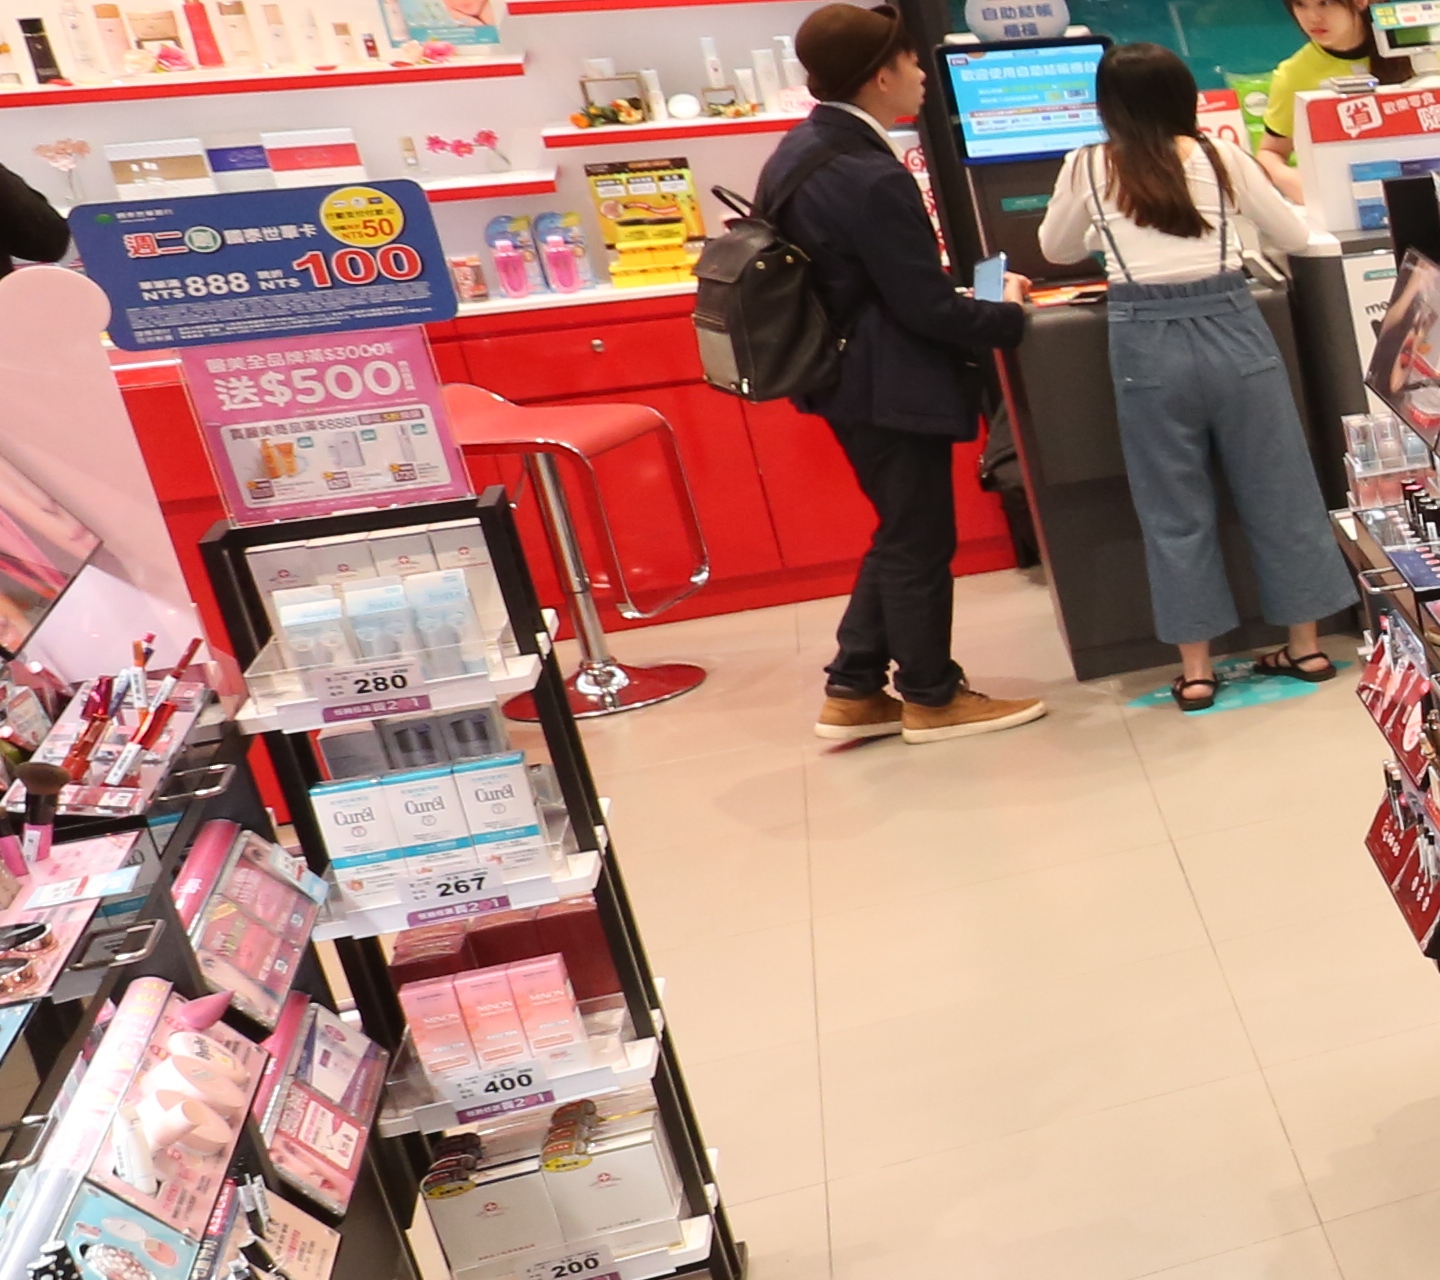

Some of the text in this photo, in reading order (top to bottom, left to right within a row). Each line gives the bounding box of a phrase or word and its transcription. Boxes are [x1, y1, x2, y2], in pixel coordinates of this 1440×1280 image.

[981, 5, 1053, 21] 自助結帳
[362, 218, 395, 239] 50
[123, 232, 188, 259] 週二
[185, 273, 251, 298] 888
[293, 244, 423, 289] 100
[214, 360, 400, 411] 送$500
[353, 671, 408, 696] 280
[403, 793, 446, 818] Curél
[473, 781, 516, 806] Curél
[333, 804, 377, 829] Curél
[437, 874, 487, 898] 267
[484, 1069, 534, 1095] 400
[551, 1253, 601, 1280] 200
